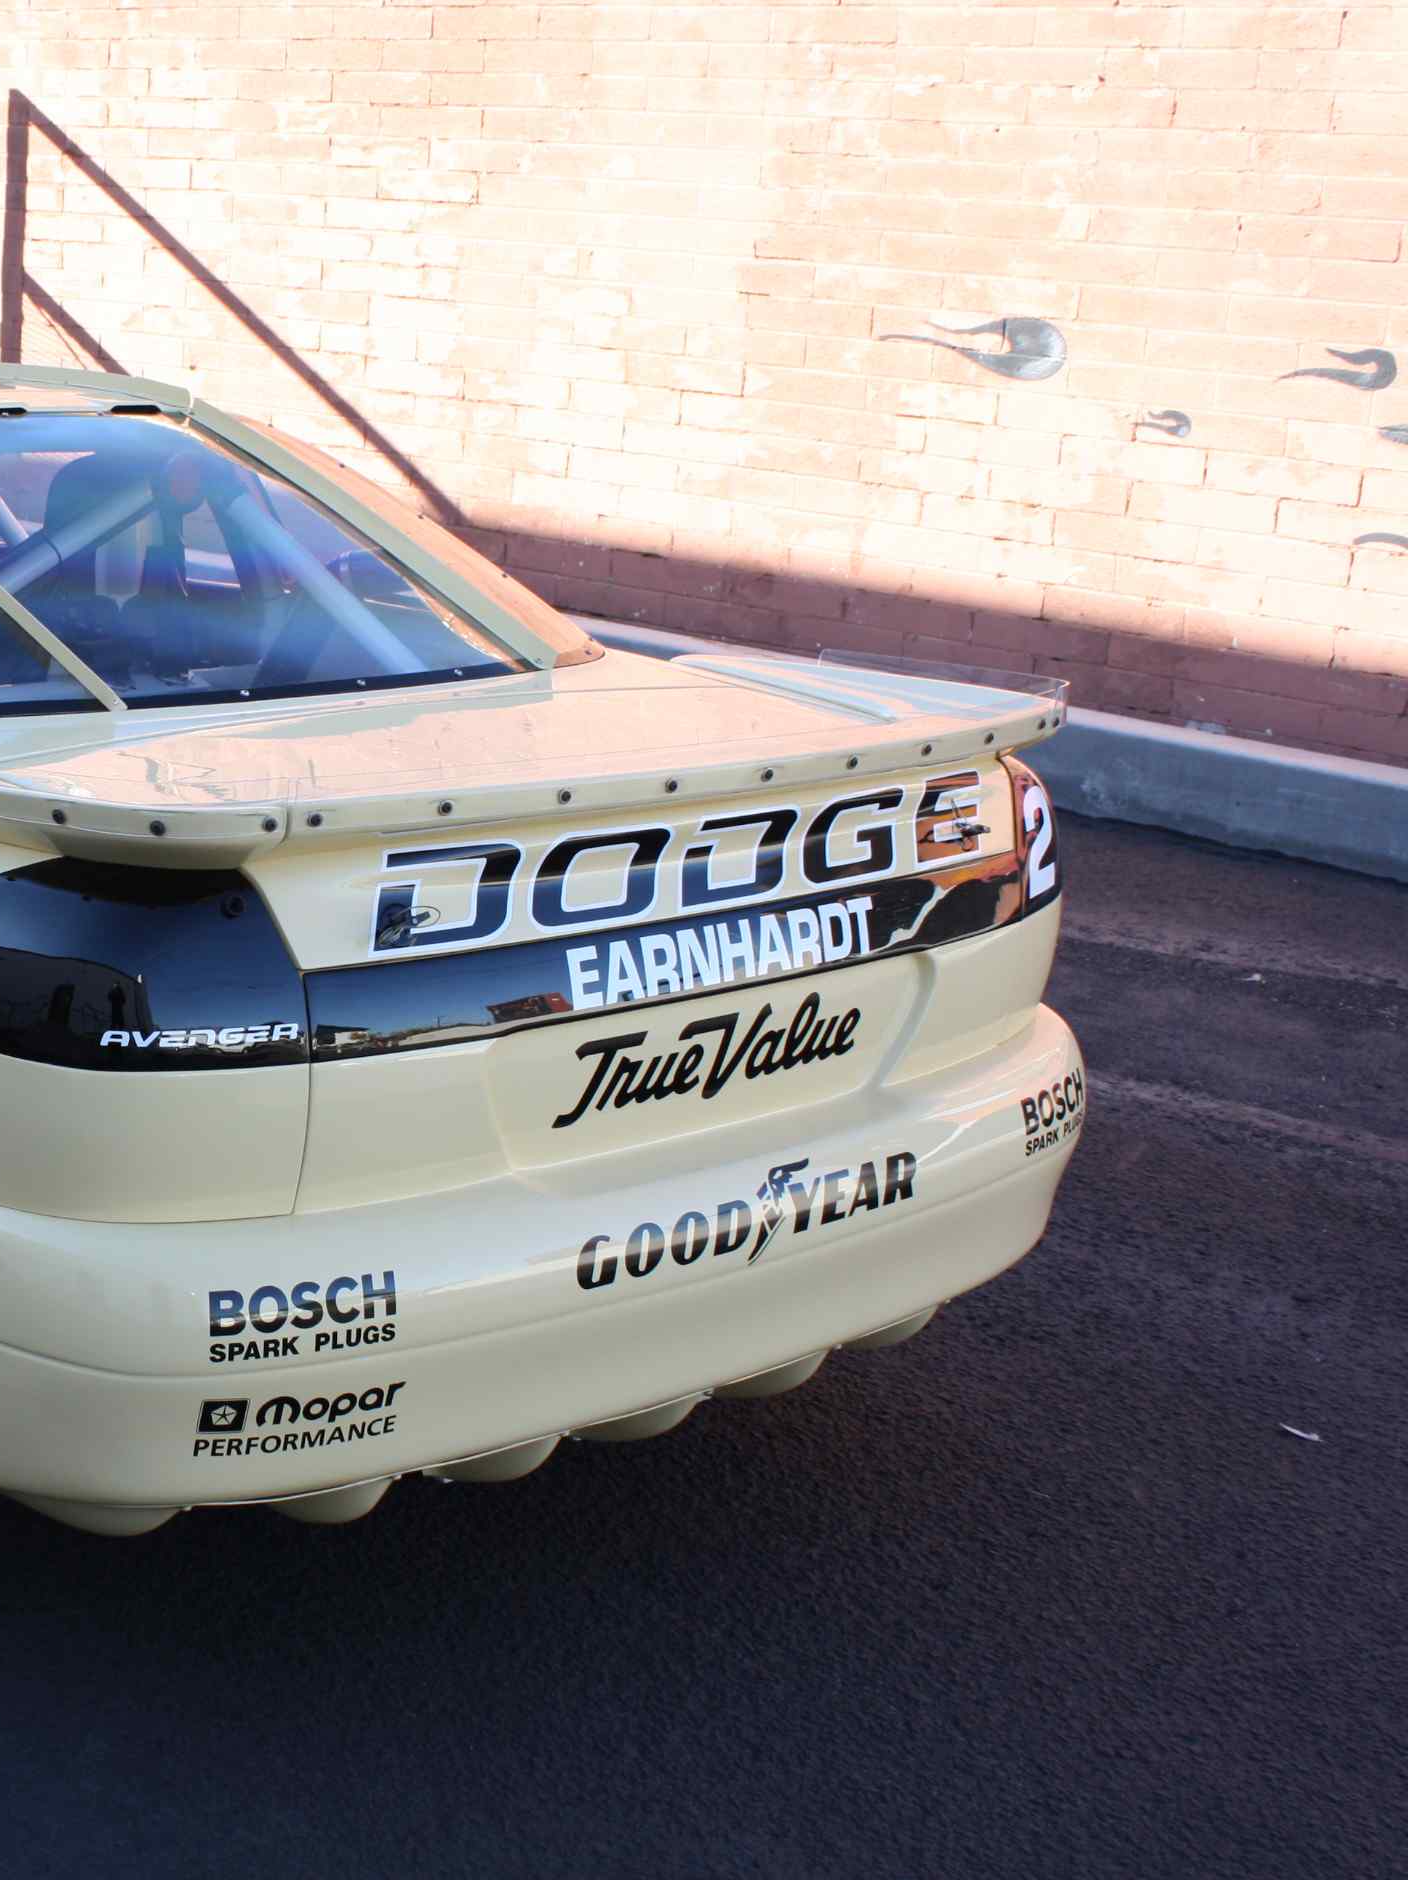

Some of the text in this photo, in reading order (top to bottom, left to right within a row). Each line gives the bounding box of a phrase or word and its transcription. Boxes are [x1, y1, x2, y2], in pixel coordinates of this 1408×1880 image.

[367, 767, 985, 958] DODGE
[1025, 785, 1056, 900] 2
[566, 896, 875, 1011] EARNHARDT
[99, 1022, 301, 1049] AVENGER
[550, 991, 862, 1129] True Value
[1021, 1067, 1084, 1136] BOSCH
[1025, 1127, 1059, 1156] SPARK
[208, 1270, 398, 1339] BOSCH
[209, 1322, 397, 1364] SPARK PLUGS
[192, 1414, 398, 1457] PERFORMANCE
[255, 1380, 406, 1428] Mopar
